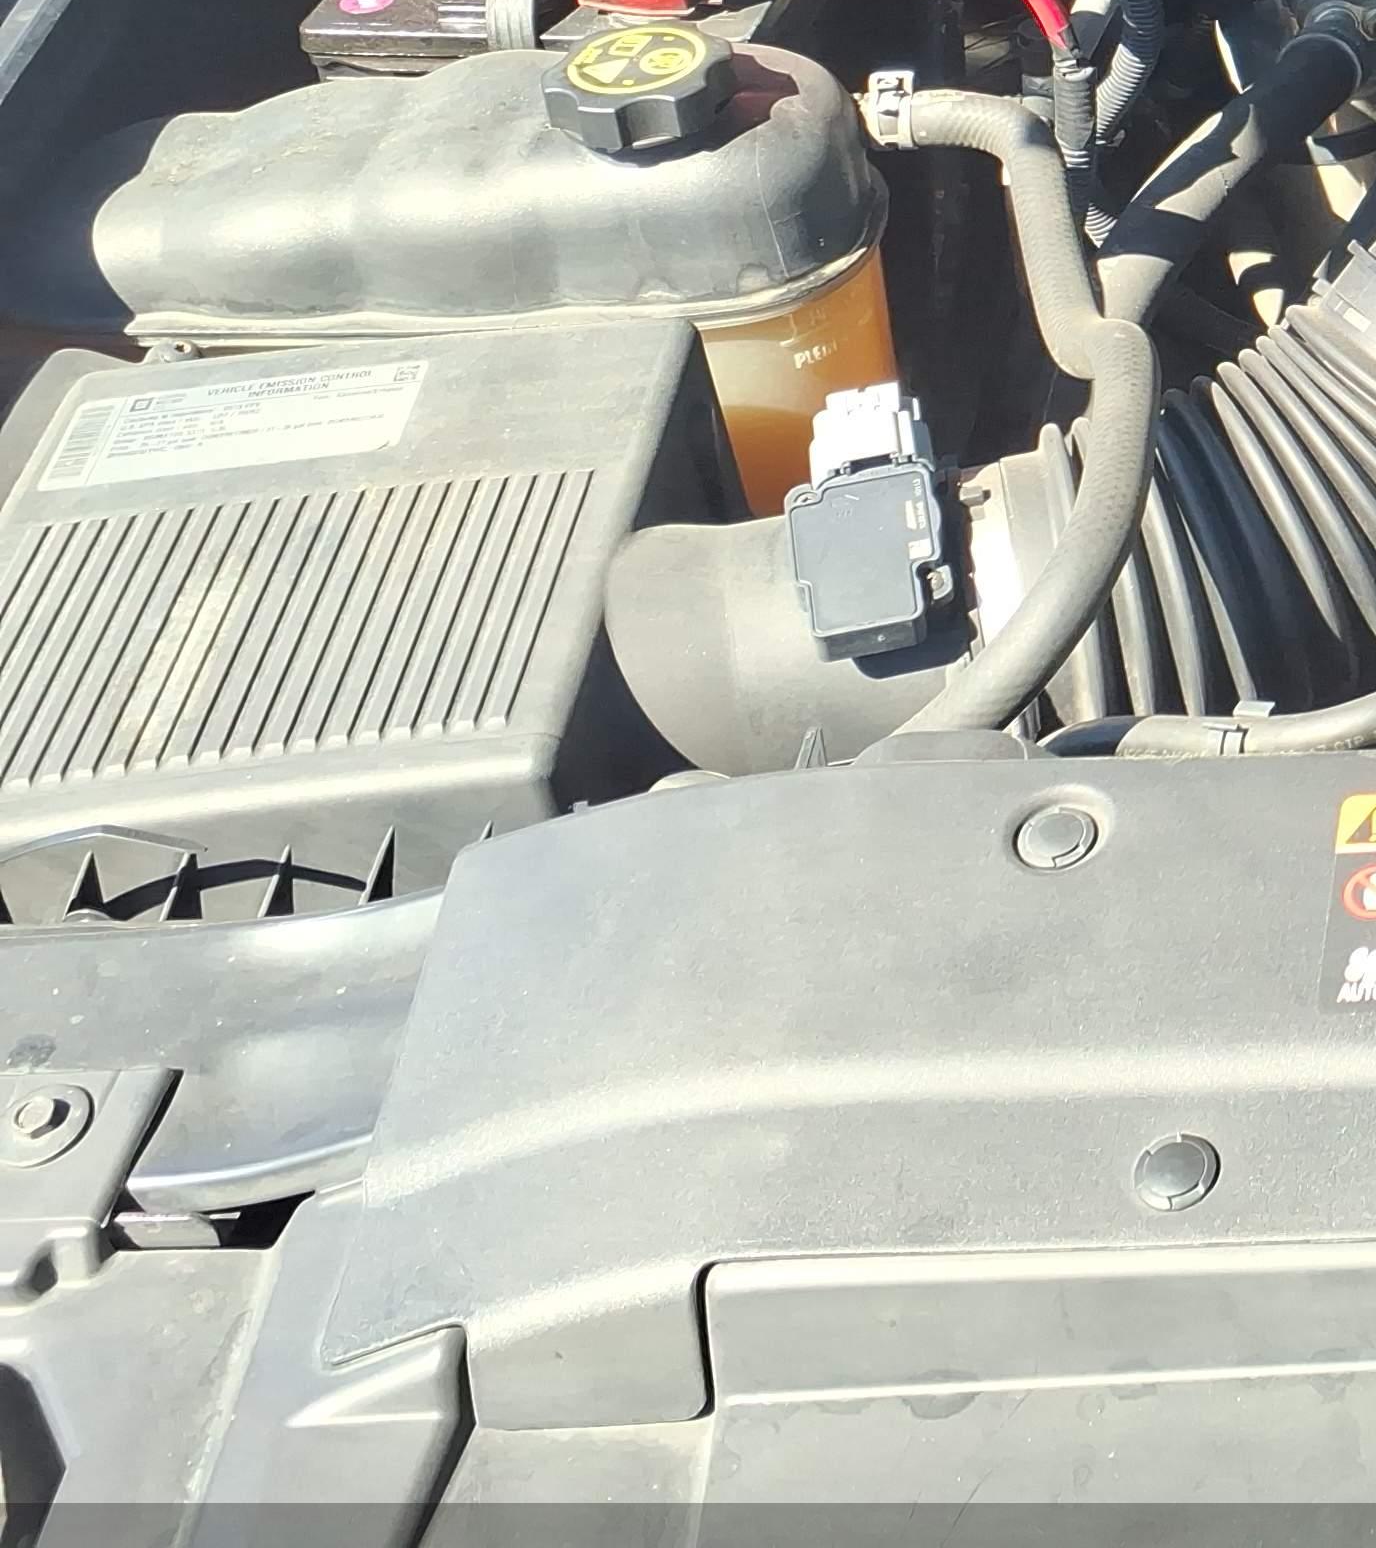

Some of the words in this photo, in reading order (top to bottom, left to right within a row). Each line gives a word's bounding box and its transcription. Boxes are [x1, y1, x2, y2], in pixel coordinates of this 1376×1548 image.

[207, 383, 256, 396] VEHICLE
[259, 376, 317, 389] EMISSION
[320, 369, 372, 382] CONTROL
[247, 381, 330, 398] INFORMATION
